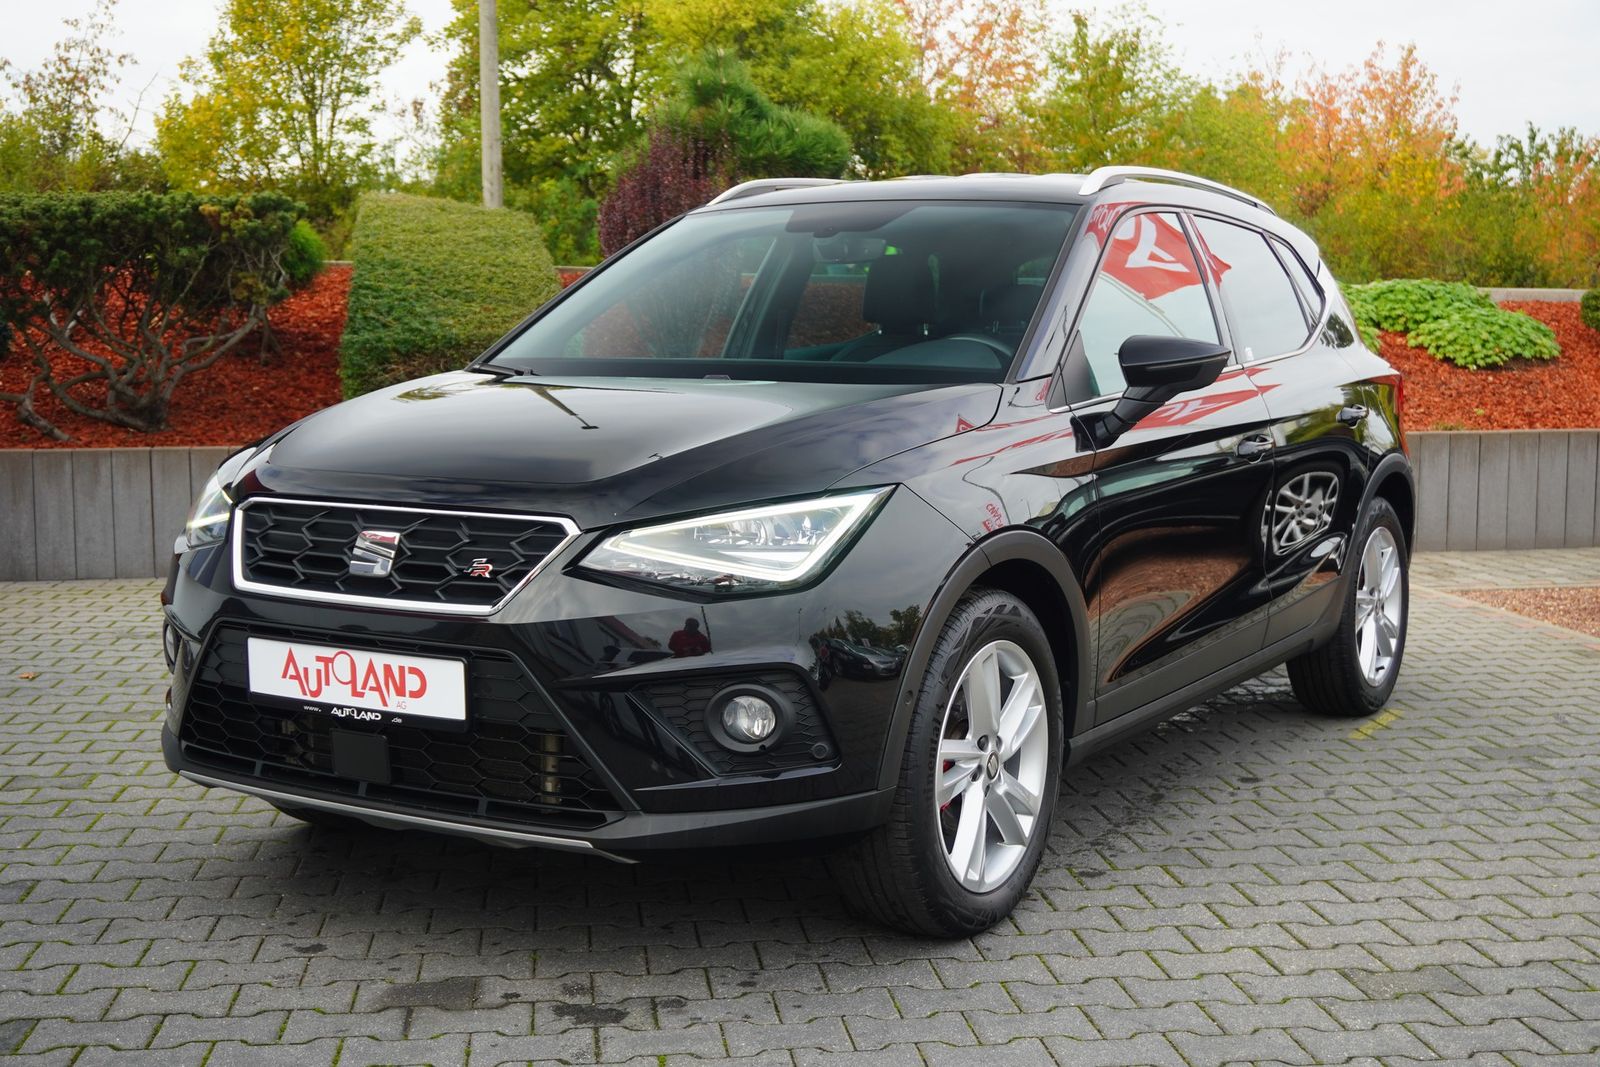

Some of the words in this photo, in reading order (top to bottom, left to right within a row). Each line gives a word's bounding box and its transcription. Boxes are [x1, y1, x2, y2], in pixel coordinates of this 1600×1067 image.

[281, 647, 427, 708] AUTOLAND
[396, 700, 407, 710] AG
[330, 706, 382, 721] AUTOLAND
